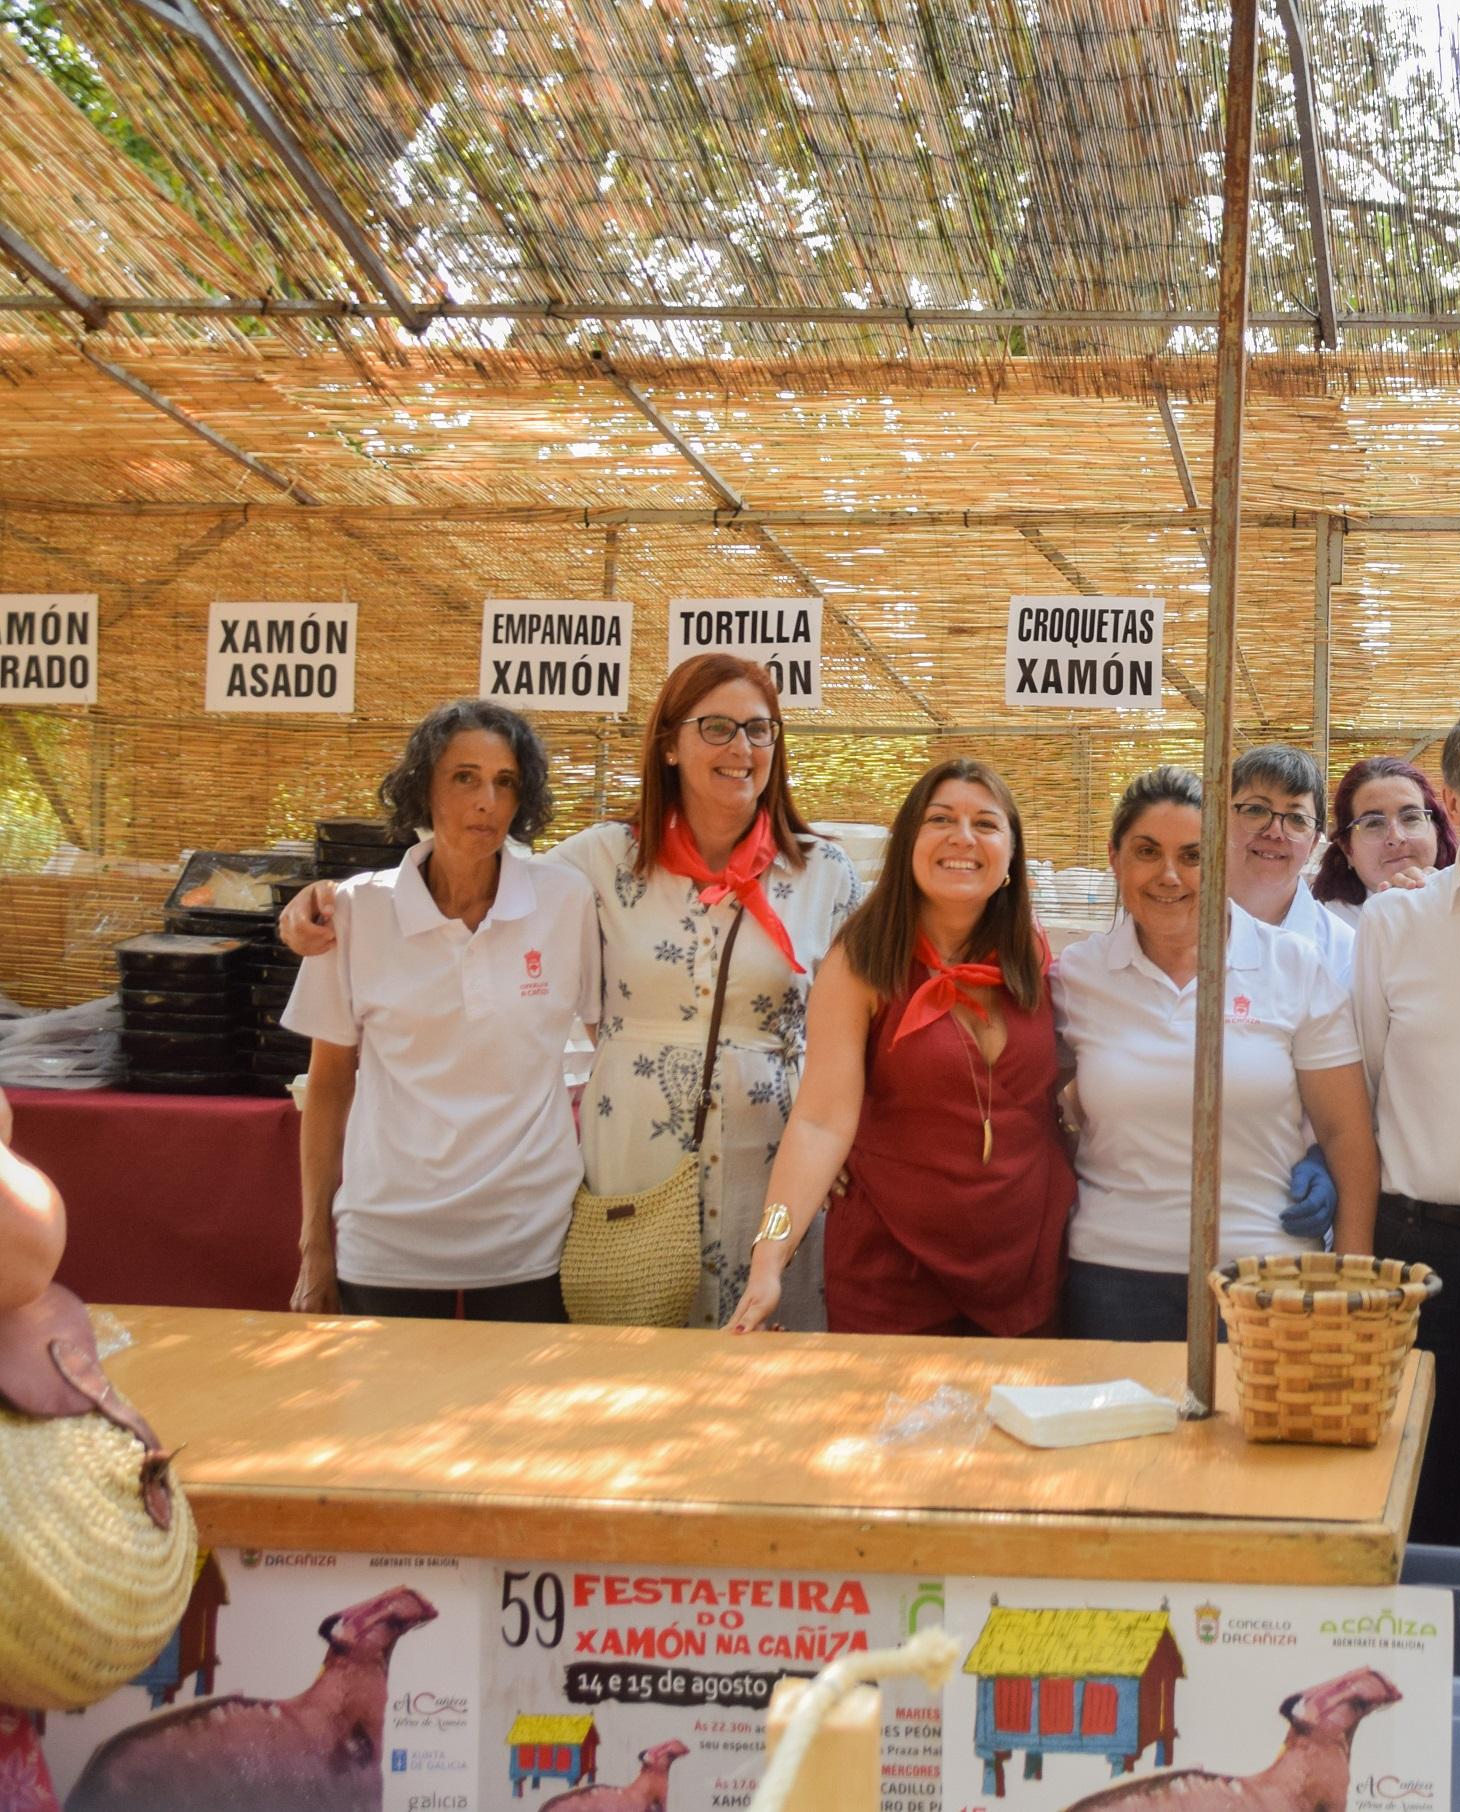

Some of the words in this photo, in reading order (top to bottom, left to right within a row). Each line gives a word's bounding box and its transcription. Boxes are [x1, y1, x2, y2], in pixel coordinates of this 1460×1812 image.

[0, 603, 89, 645] MÓN
[219, 612, 348, 656] XAMÓN
[492, 614, 622, 646] EMPANADA
[680, 609, 811, 645] TORTILLA
[1018, 607, 1154, 648] CROQUETAS
[226, 663, 338, 698] ASADO
[490, 654, 621, 696] XAMÓN
[1017, 652, 1153, 696] XAMÓN
[501, 1570, 566, 1649] 59
[572, 1573, 870, 1615] FESTA-FEIRA
[697, 1610, 744, 1630] DO
[575, 1621, 706, 1660] XAMÓN
[715, 1634, 751, 1655] NA
[578, 1672, 604, 1695] 14
[609, 1677, 621, 1693] e
[628, 1673, 653, 1698] 15
[658, 1669, 686, 1696] de
[692, 1675, 768, 1704] agosto
[896, 1707, 941, 1720] MARTES
[712, 1793, 751, 1807] XAMÓ
